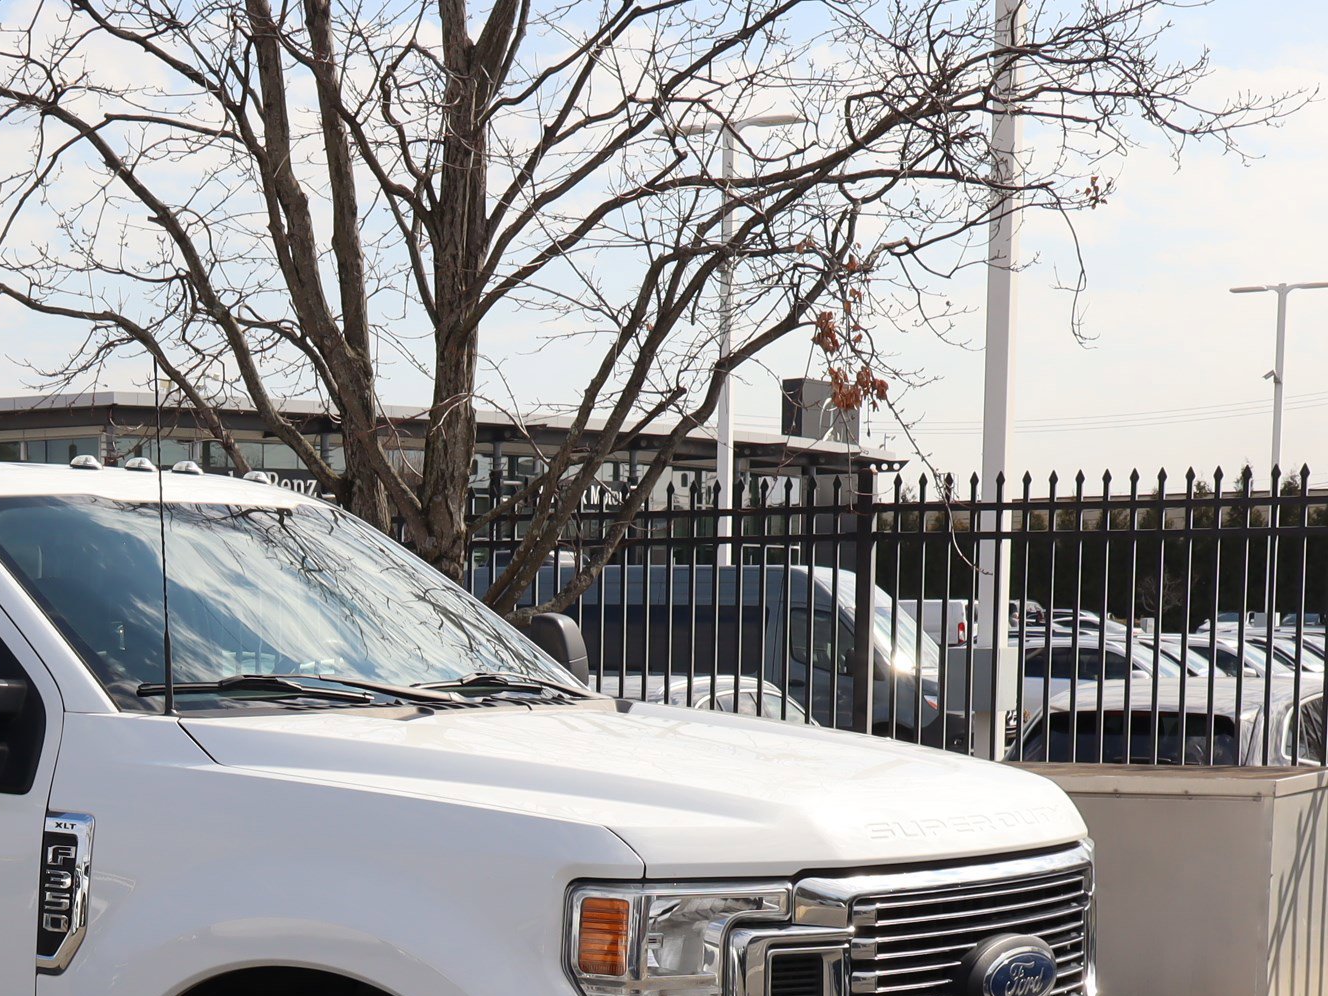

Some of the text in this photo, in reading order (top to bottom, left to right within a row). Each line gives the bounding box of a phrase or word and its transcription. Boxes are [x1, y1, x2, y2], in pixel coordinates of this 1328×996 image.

[55, 821, 77, 830] XLT
[864, 805, 1060, 840] SUPER DUTY
